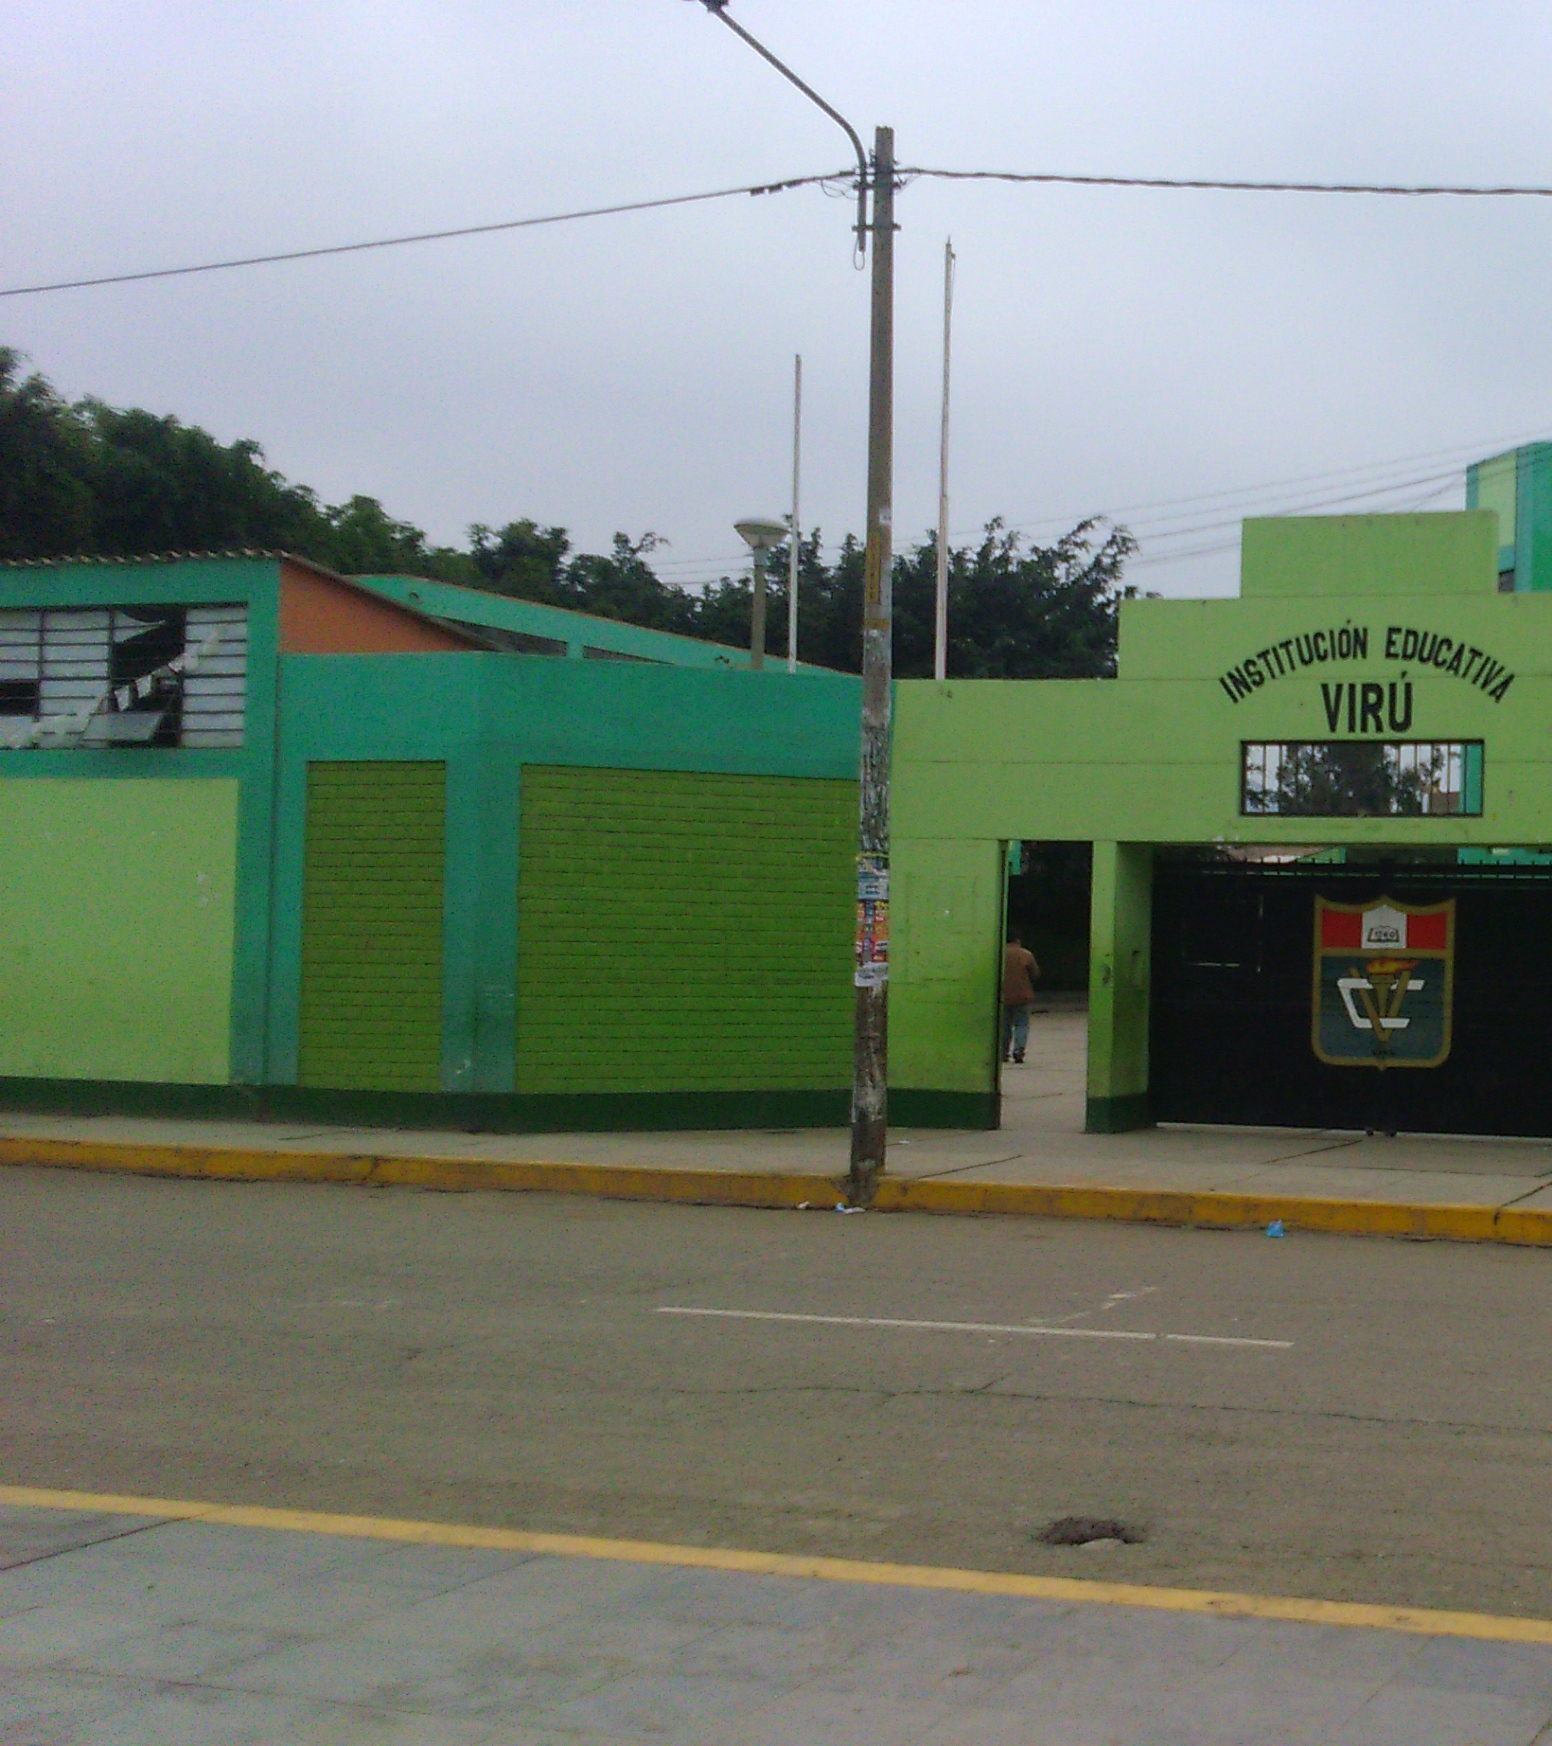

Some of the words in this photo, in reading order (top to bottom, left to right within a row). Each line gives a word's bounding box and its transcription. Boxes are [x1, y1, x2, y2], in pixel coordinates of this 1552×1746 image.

[1219, 619, 1369, 704] INSTITUCIÓN
[1384, 627, 1516, 704] EDUCATIVA
[1320, 670, 1413, 733] VIRÚ
